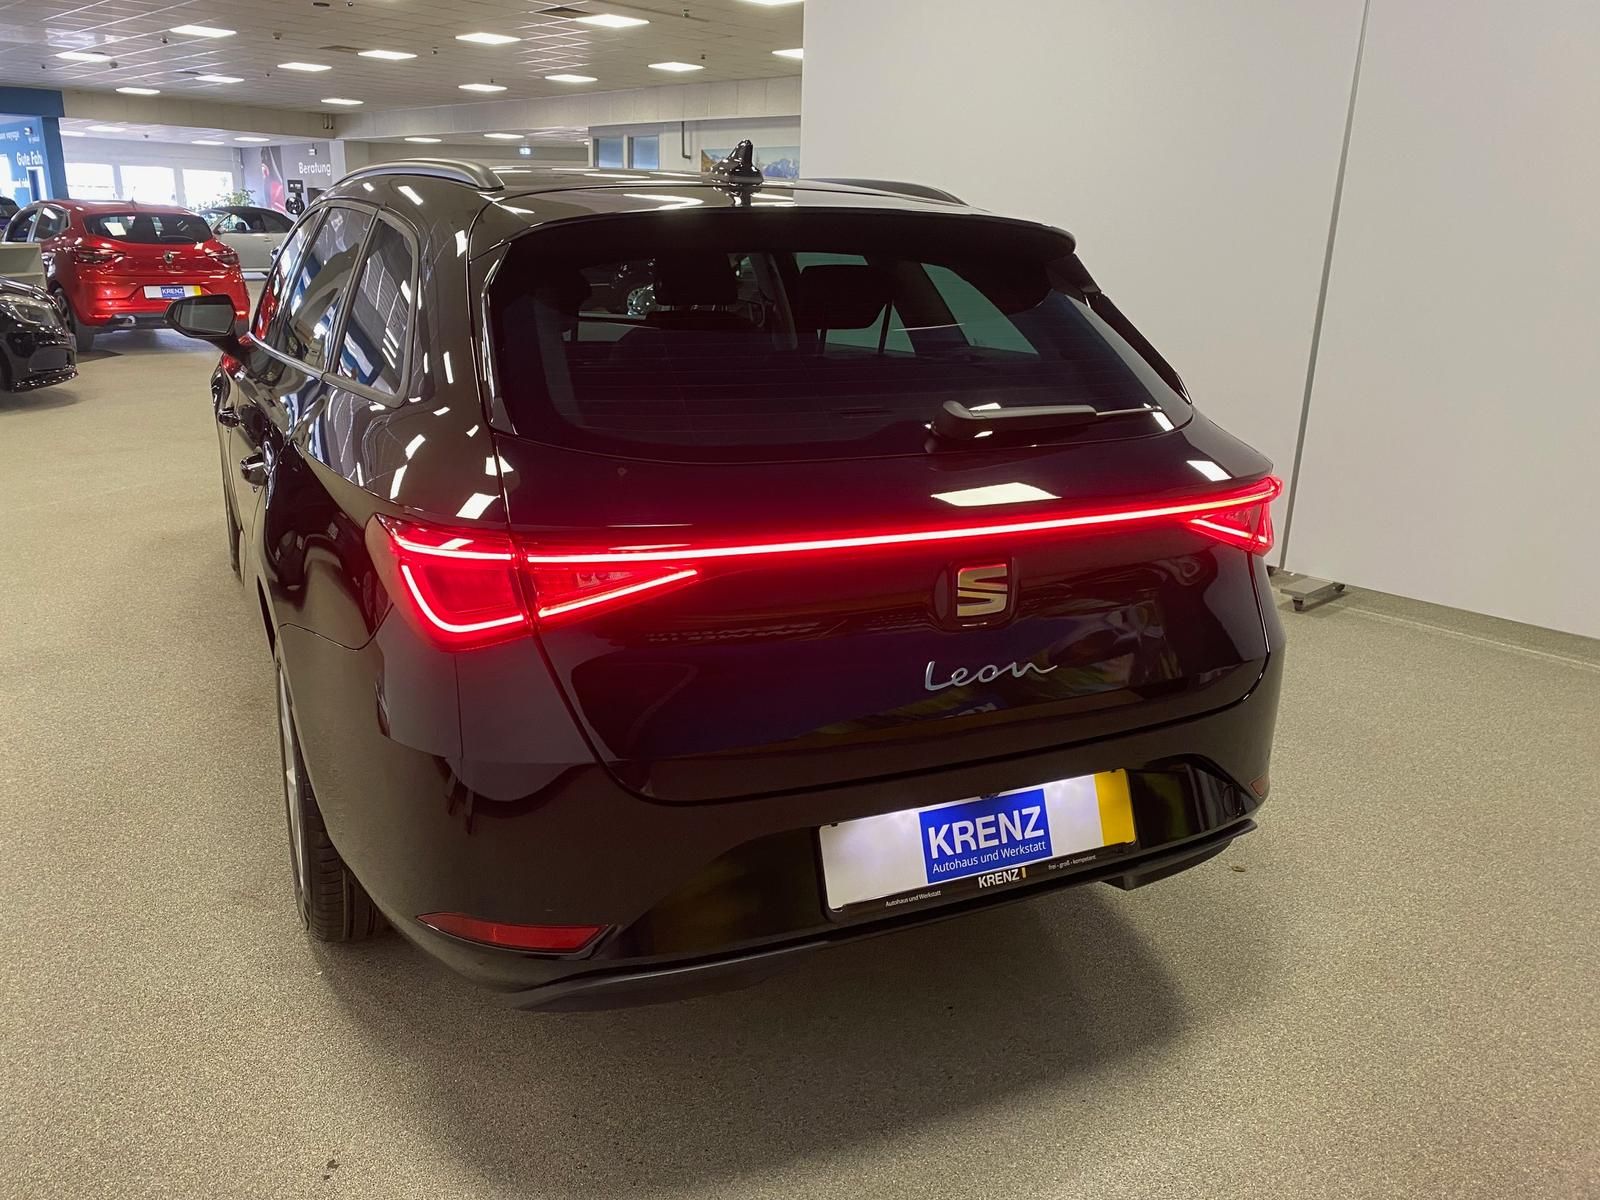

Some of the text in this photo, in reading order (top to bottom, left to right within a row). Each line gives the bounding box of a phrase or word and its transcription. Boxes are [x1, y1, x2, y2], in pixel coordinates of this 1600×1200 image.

[16, 151, 30, 166] Gute
[298, 162, 331, 176] Beratung
[924, 660, 1058, 691] Leon
[928, 806, 1045, 859] KRENZ
[932, 841, 1047, 875] Autohaus und Werkstatt
[977, 868, 1020, 889] KRENZ
[885, 890, 942, 907] Autohaus und Werkstatt
